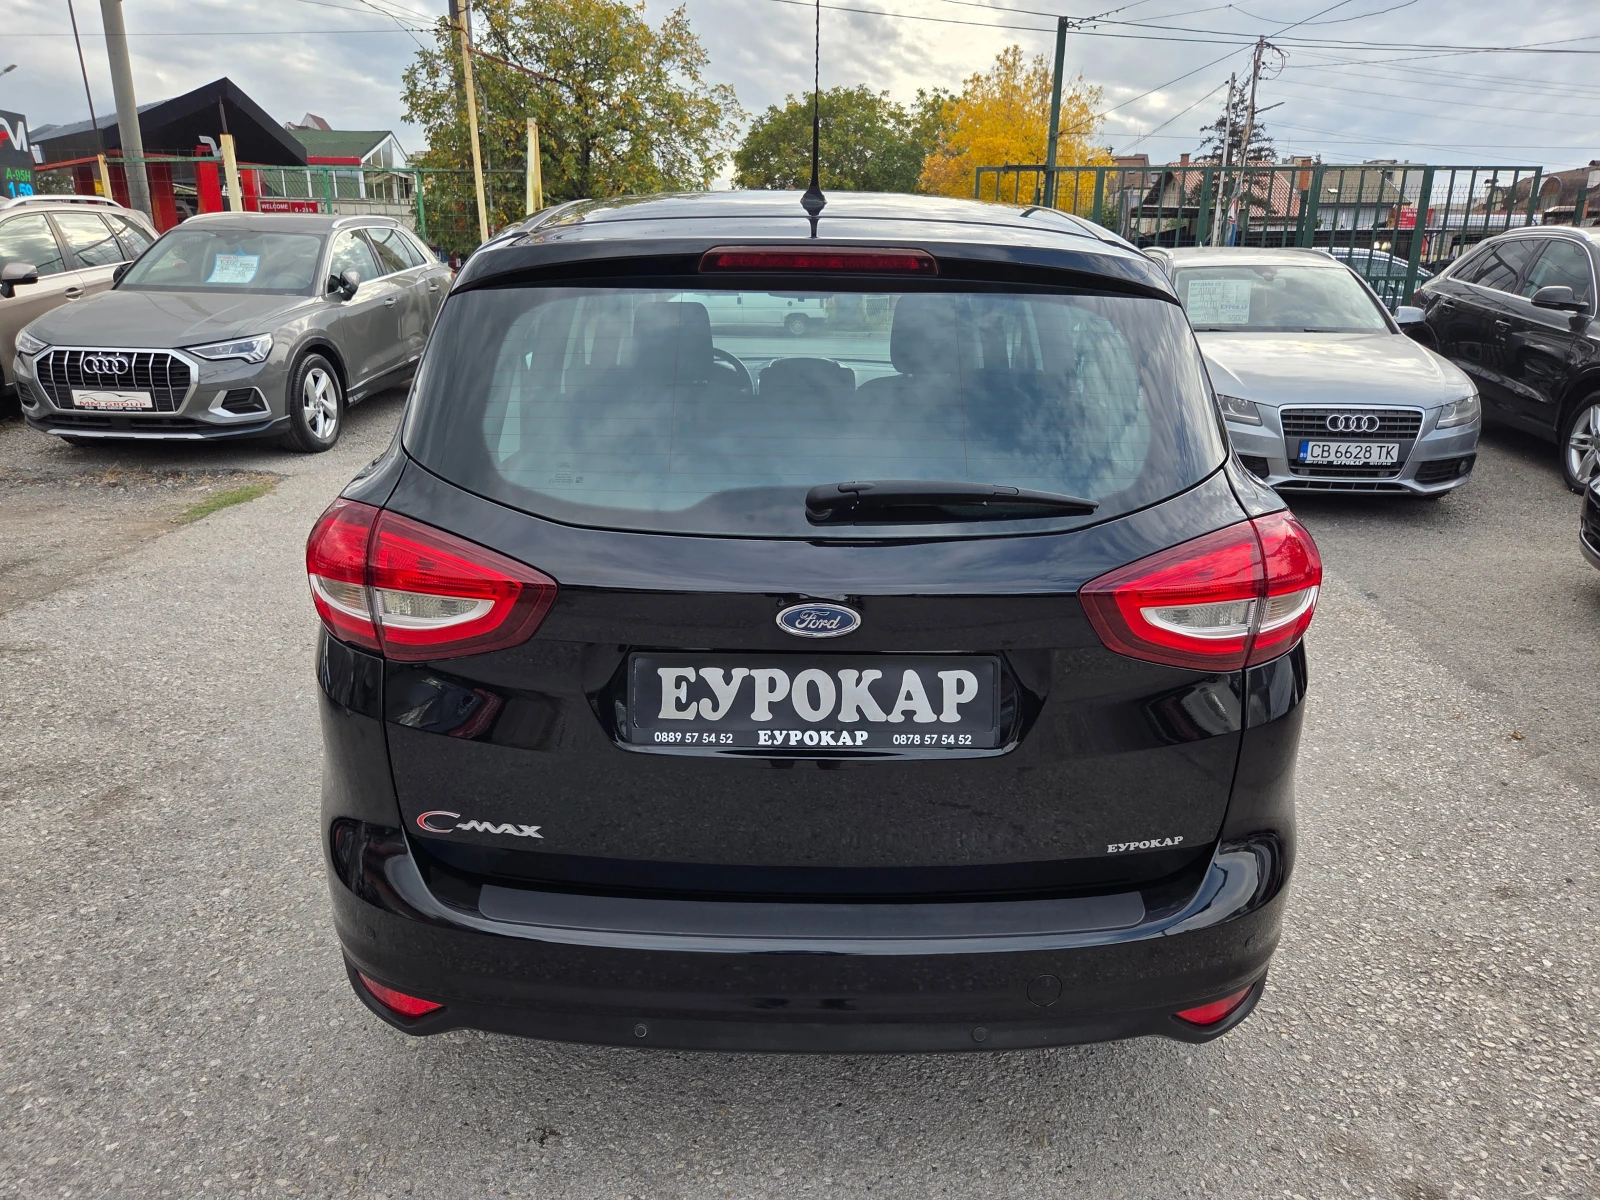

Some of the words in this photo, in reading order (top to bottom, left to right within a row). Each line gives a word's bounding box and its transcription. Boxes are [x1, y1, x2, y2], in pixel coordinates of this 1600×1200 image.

[1310, 444, 1331, 458] CB
[1334, 444, 1373, 460] 6628
[1376, 445, 1396, 460] TK
[795, 610, 841, 629] Ford
[657, 667, 979, 722] ЕУРОКАР
[654, 731, 682, 742] 0889
[684, 732, 699, 743] 57
[702, 733, 716, 743] 54
[719, 733, 734, 744] 52
[757, 730, 869, 746] ЕУРОКАР
[892, 734, 921, 745] 0878
[924, 734, 938, 745] 57
[940, 734, 955, 745] 54
[957, 734, 972, 745] 52
[1107, 835, 1184, 853] ЕУРОКАР
